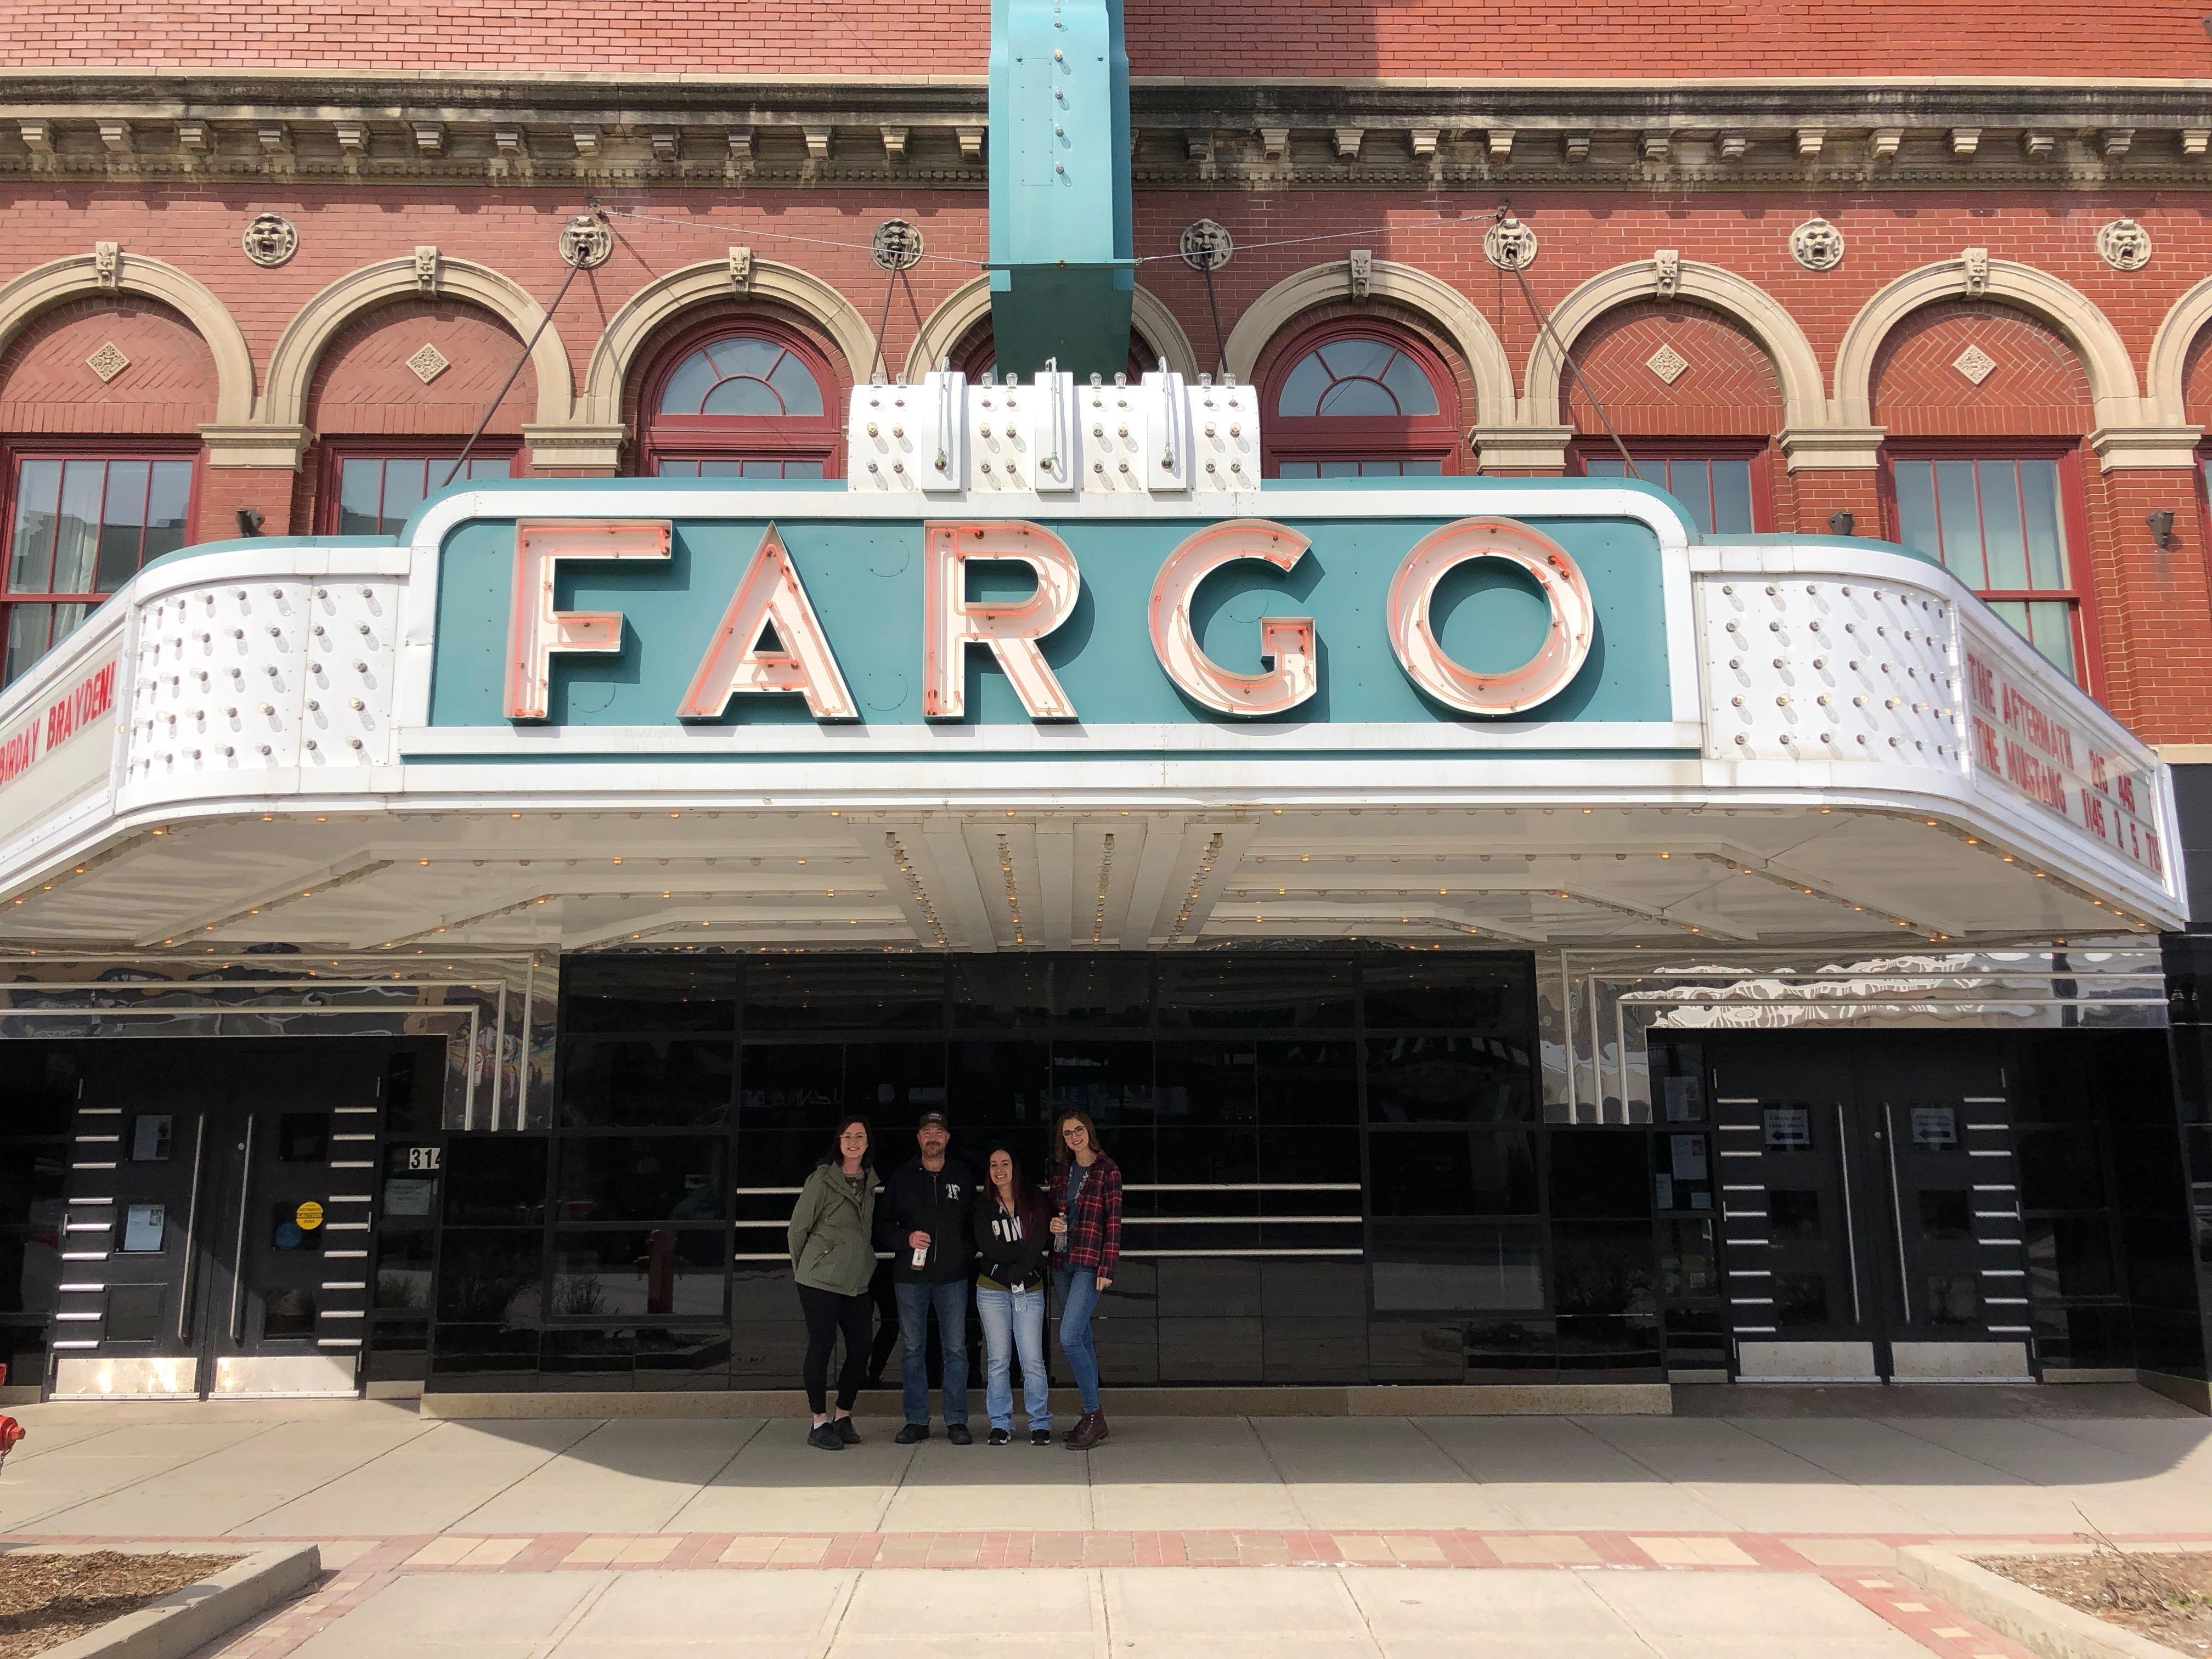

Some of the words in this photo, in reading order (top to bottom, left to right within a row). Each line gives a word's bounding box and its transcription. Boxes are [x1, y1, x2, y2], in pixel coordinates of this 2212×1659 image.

[503, 516, 1594, 720] FARGO
[47, 660, 116, 752] BRAYDEN!
[1967, 652, 1996, 715] THE
[2002, 682, 2074, 771] AFTERMATH
[1972, 715, 2001, 775] THE
[2004, 736, 2067, 814] MUSTANG
[2130, 822, 2140, 859] 5
[991, 1216, 1023, 1243] PIN
